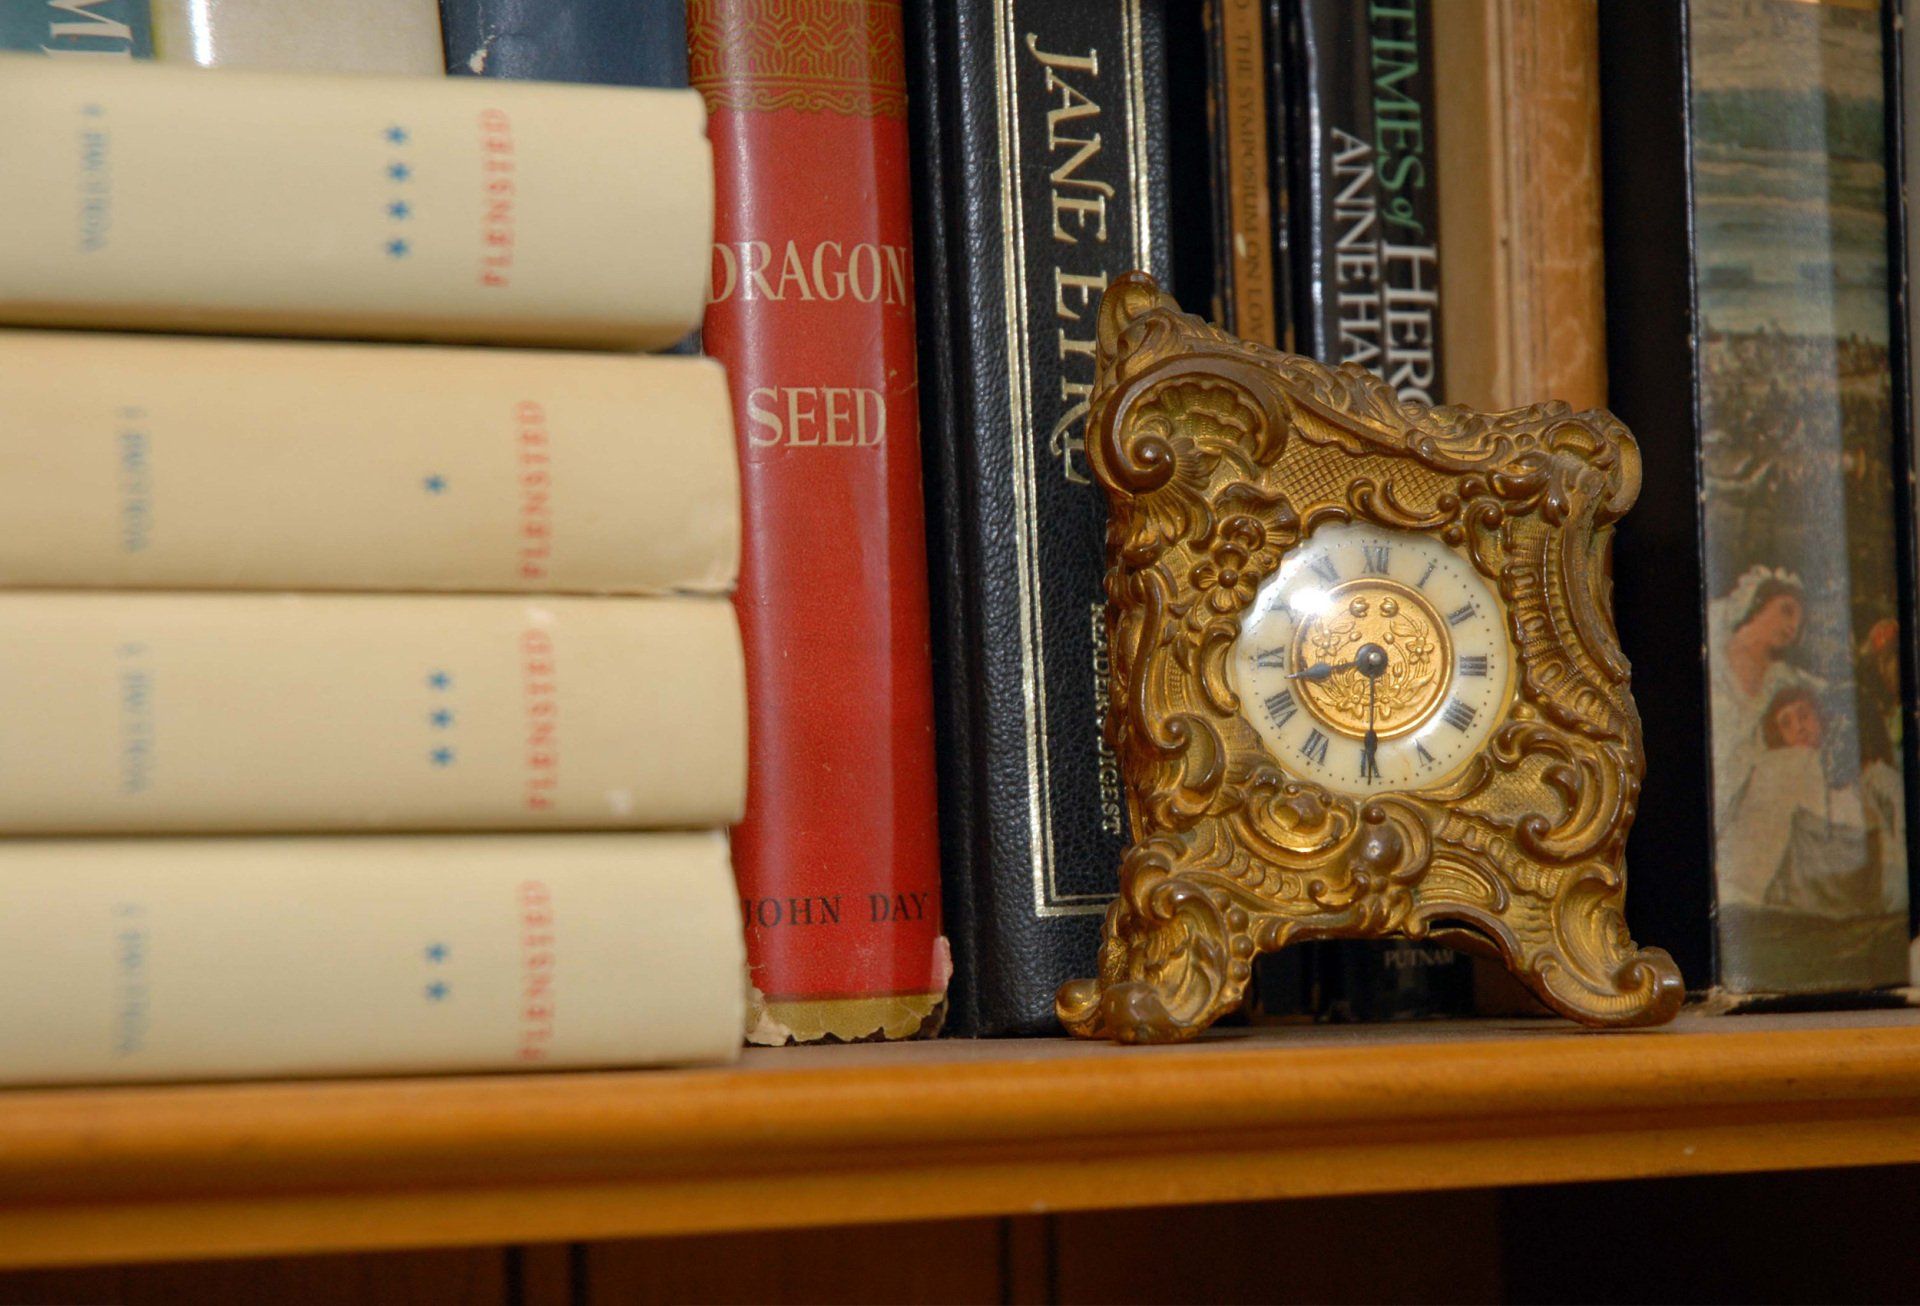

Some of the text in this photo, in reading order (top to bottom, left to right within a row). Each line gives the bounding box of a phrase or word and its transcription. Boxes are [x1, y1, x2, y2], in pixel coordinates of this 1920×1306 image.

[1369, 0, 1425, 190] TIMES
[1026, 32, 1116, 243] JANE
[1239, 86, 1259, 231] SYMPOSIUM
[1381, 197, 1425, 236] of
[1246, 241, 1263, 280] ON
[1330, 127, 1382, 378] ANNE HA
[704, 240, 907, 306] DRAGON
[746, 384, 888, 449] SEED
[1362, 546, 1391, 575] XII
[1417, 562, 1436, 589] I
[1448, 601, 1478, 626] II
[1257, 646, 1285, 669] IX
[1459, 653, 1488, 678] III
[1415, 738, 1435, 767] V
[744, 892, 928, 929] JOHN DAY
